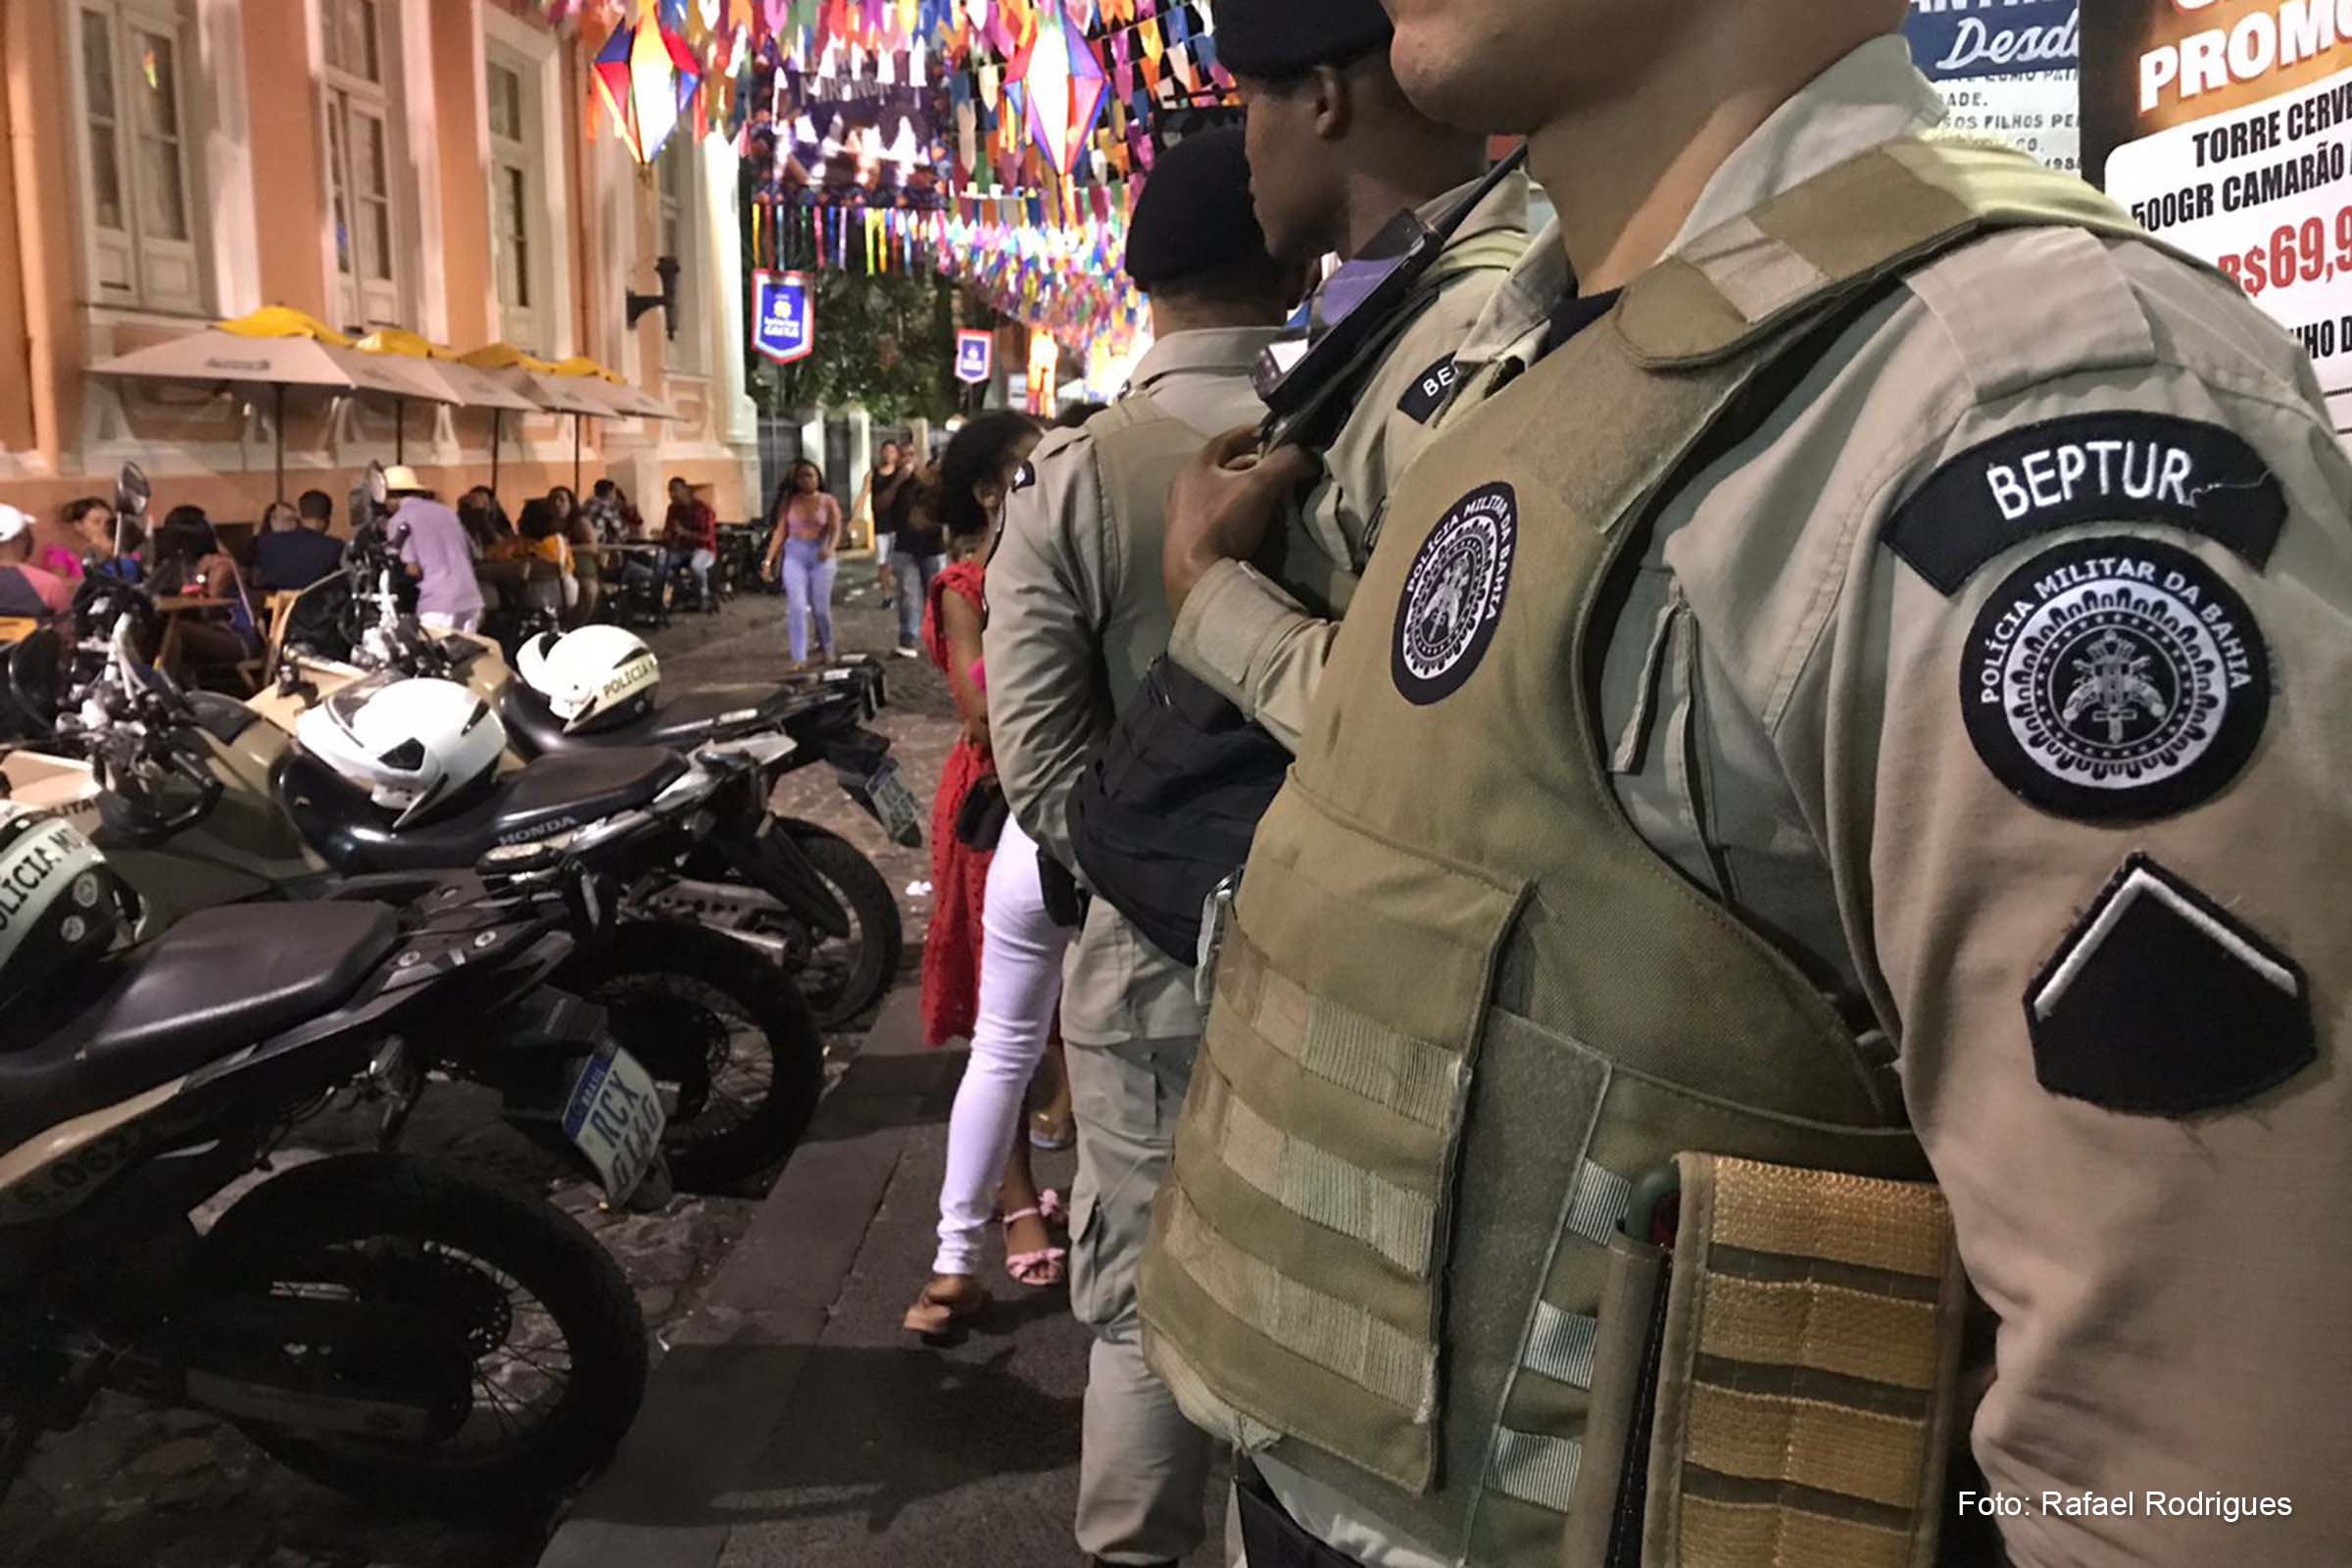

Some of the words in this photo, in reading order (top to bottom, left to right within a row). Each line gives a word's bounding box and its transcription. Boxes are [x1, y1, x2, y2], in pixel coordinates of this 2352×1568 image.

[1946, 92, 1988, 107] ADE.
[1984, 114, 2043, 129] FILHOS
[2192, 110, 2280, 168] TORRE
[2132, 183, 2214, 232] 500GR
[2223, 140, 2344, 213] CAMARÃO
[1423, 366, 1455, 397] BE
[1986, 441, 2193, 520] BEPTUR
[1463, 495, 1508, 518] MILITAR
[1486, 544, 1511, 619] BAHIA
[1981, 601, 2034, 704] POLÍCIA
[2034, 557, 2155, 598] MILITAR
[2163, 571, 2199, 604] DA
[2200, 604, 2252, 689] BAHIA
[498, 815, 578, 845] HONDA
[0, 847, 62, 930] LICIA
[590, 1069, 639, 1150] RCX
